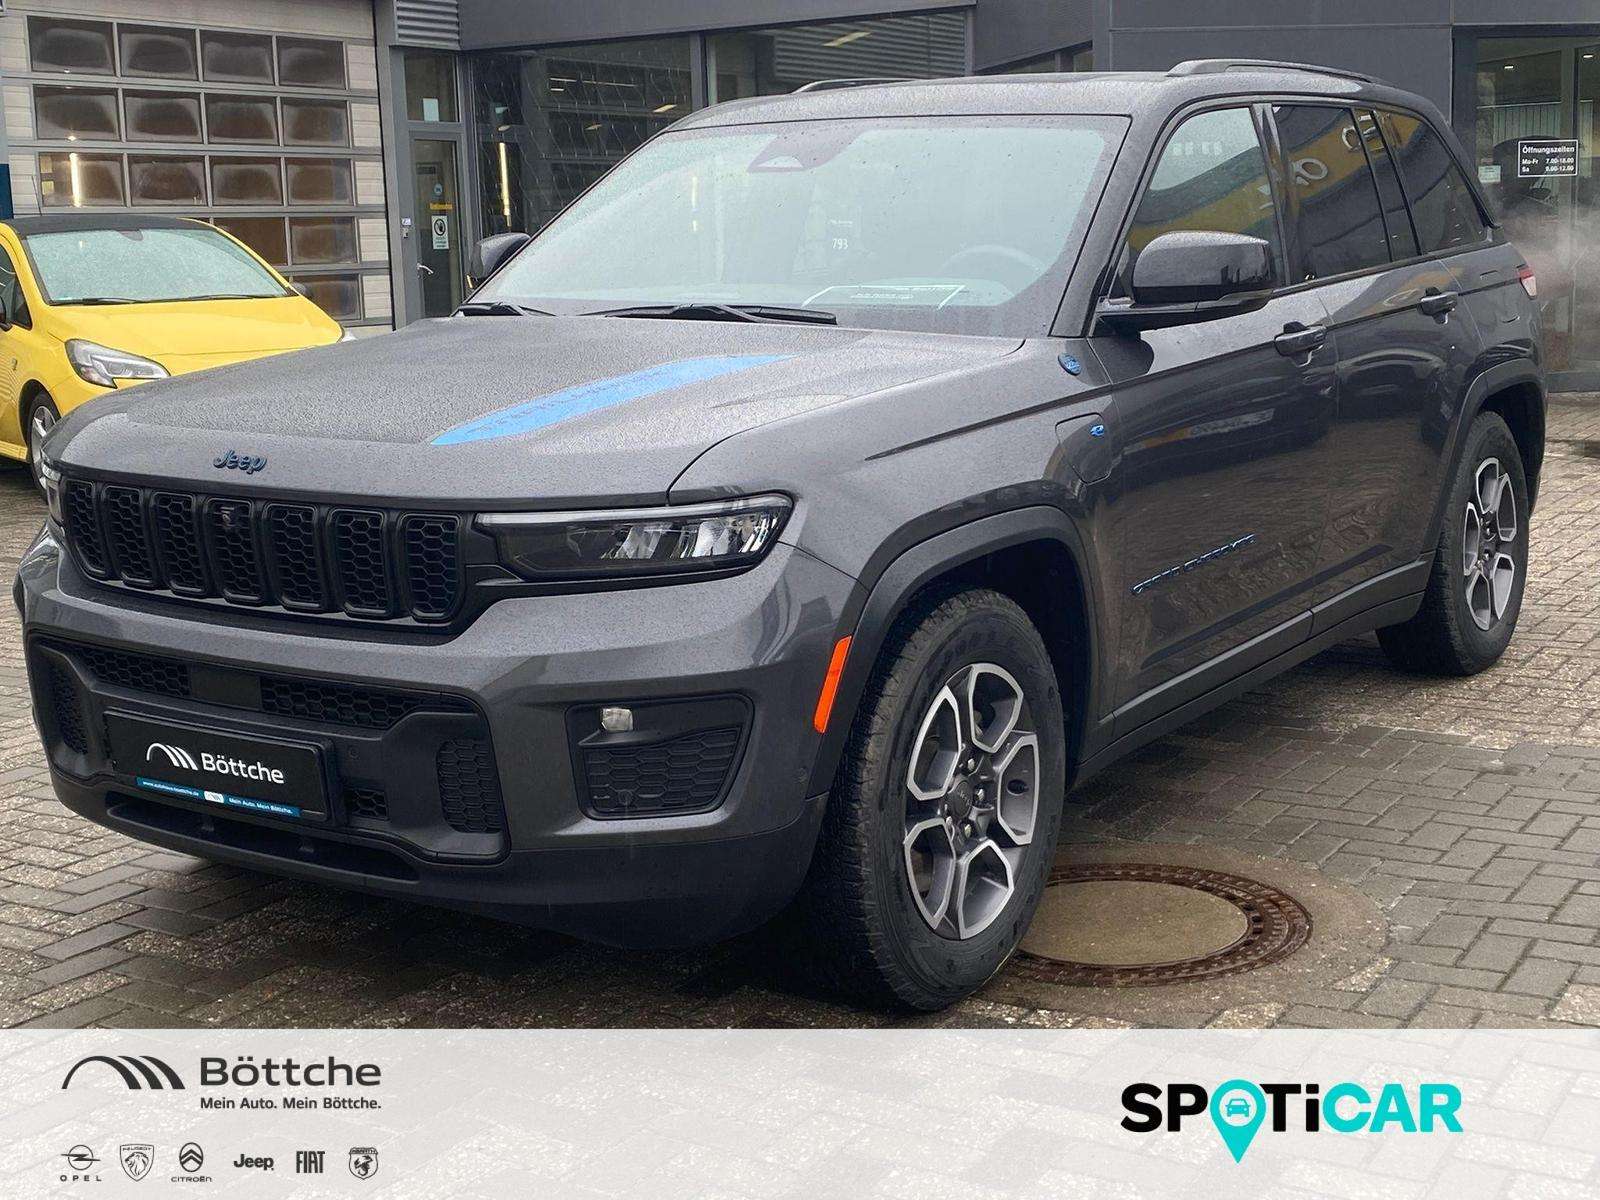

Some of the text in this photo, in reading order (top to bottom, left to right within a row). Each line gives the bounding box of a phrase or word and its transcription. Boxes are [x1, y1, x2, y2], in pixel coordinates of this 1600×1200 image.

[1522, 145, 1575, 155] Öffnungszeiten
[832, 238, 849, 249] 793
[212, 449, 268, 475] Jeep
[200, 752, 285, 784] Böttche
